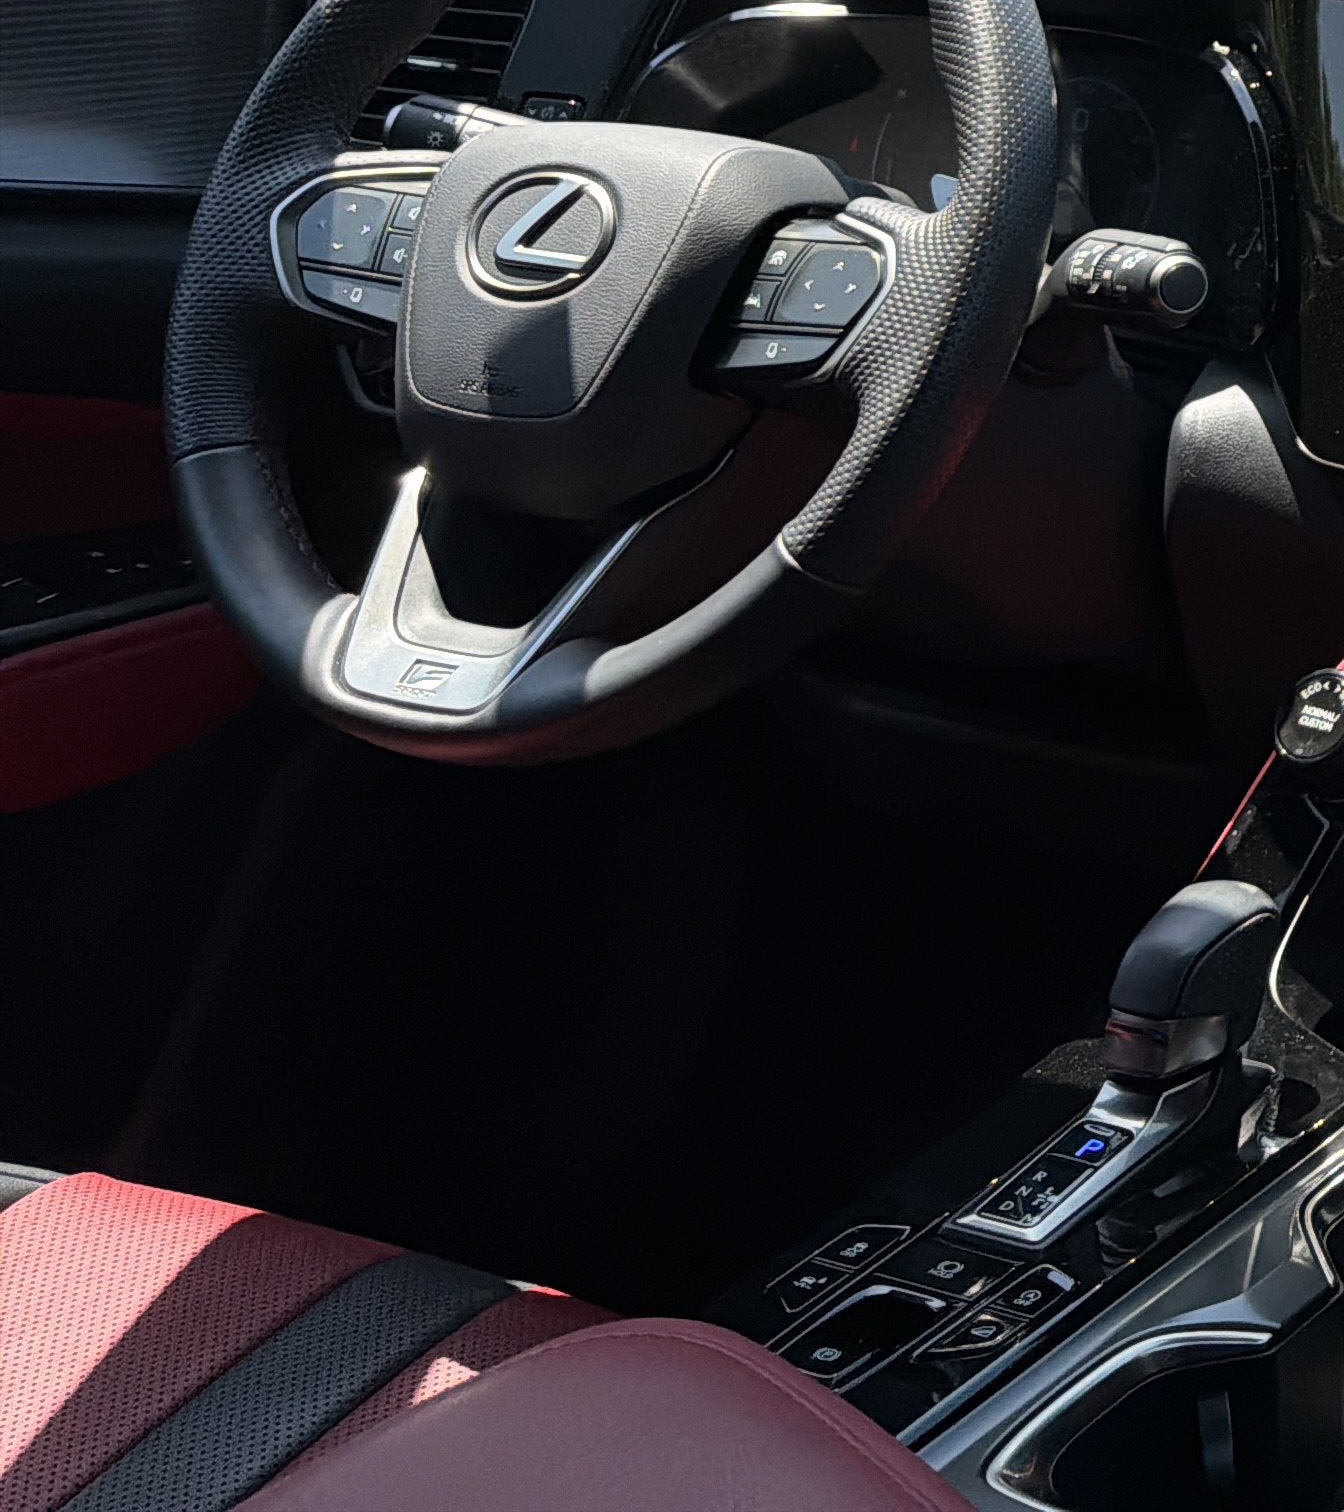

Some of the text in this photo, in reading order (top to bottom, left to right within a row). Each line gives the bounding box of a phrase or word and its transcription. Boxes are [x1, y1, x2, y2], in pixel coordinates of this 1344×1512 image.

[1300, 682, 1322, 699] ECO
[1301, 705, 1341, 723] NORMAL/
[1298, 716, 1334, 733] CUSTOM
[1075, 1138, 1107, 1158] P
[1032, 1170, 1048, 1183] R
[1014, 1185, 1034, 1198] N
[998, 1200, 1015, 1212] D
[927, 1267, 955, 1280] HOLD
